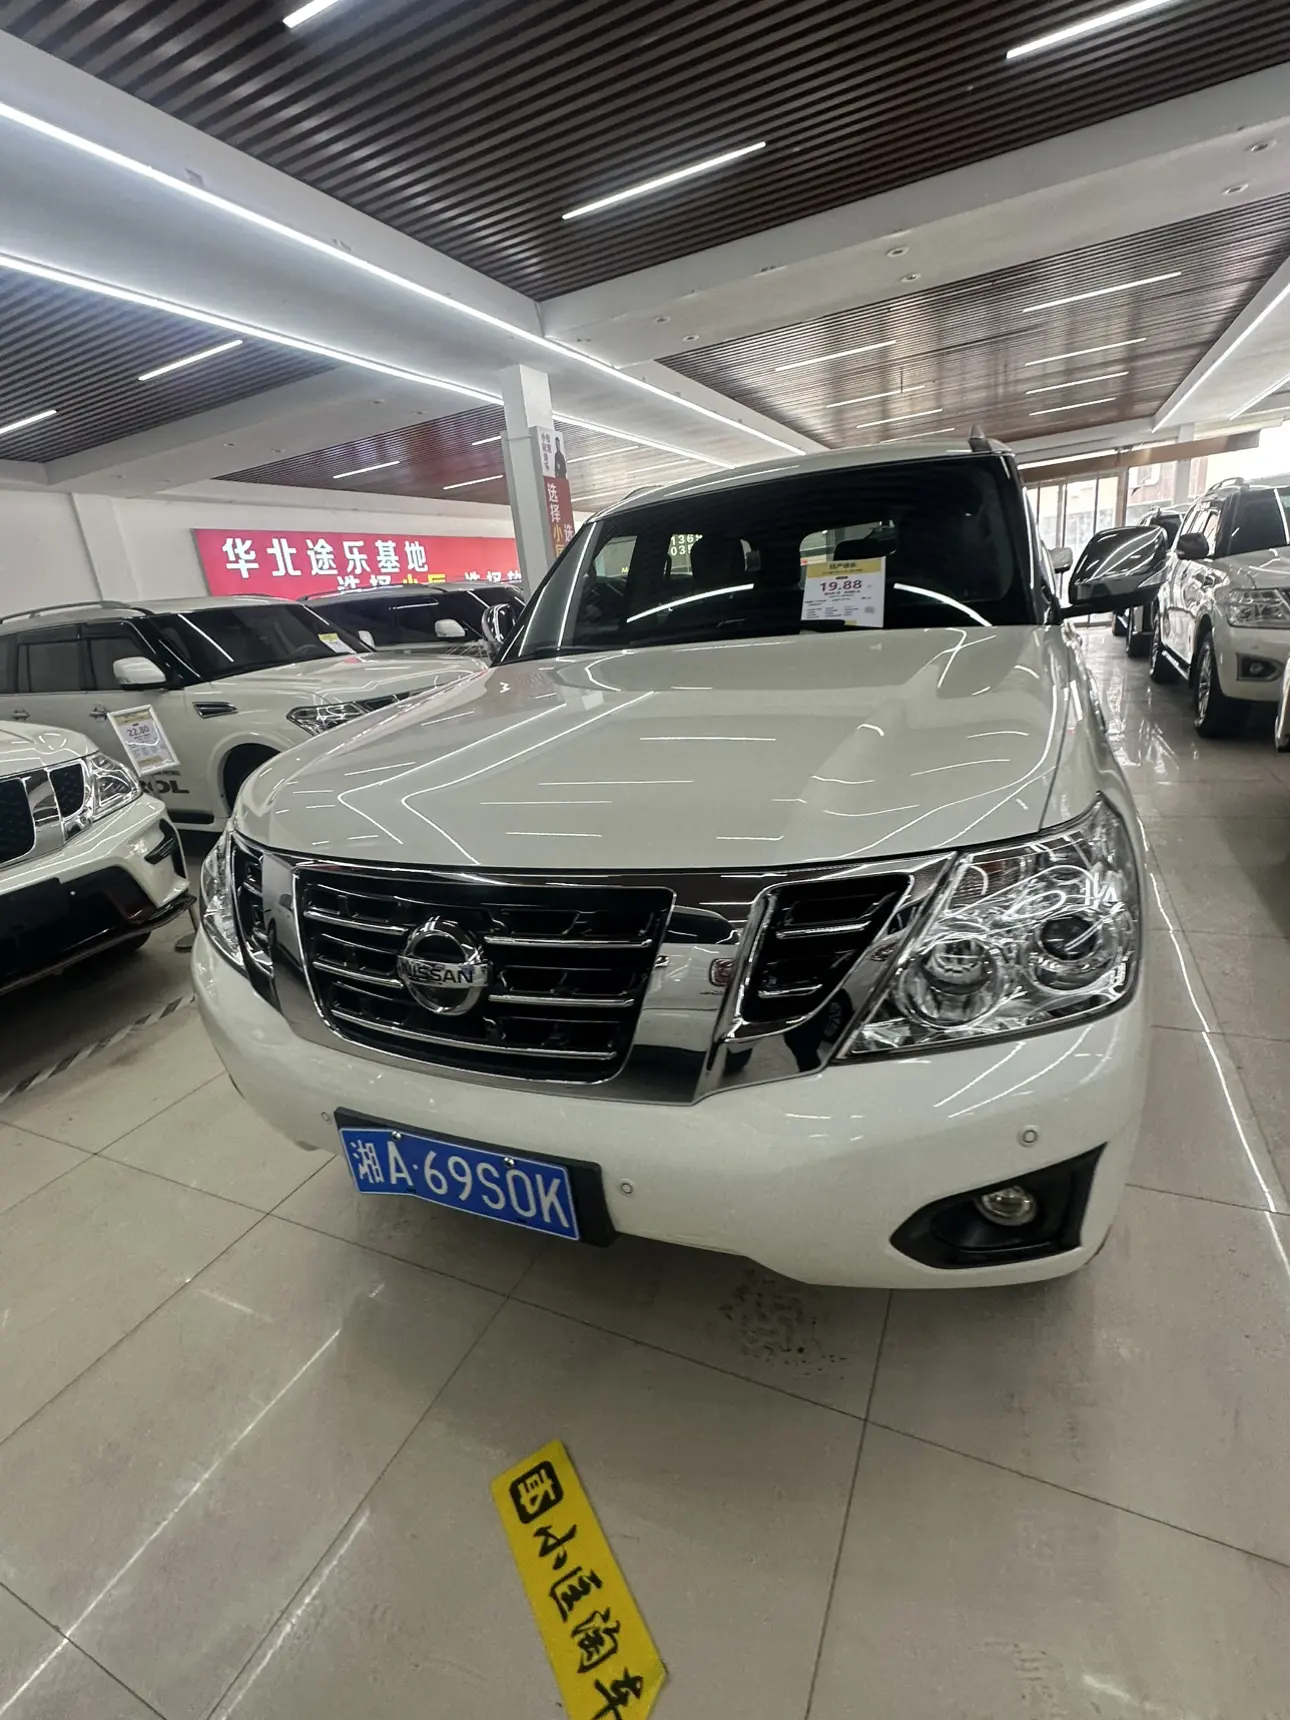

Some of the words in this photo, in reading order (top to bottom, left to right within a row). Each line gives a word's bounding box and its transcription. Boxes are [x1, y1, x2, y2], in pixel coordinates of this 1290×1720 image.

[221, 537, 429, 579] 华北途乐基地
[820, 580, 862, 592] 19.88
[127, 725, 150, 737] 22.80
[403, 960, 474, 984] NISSAN
